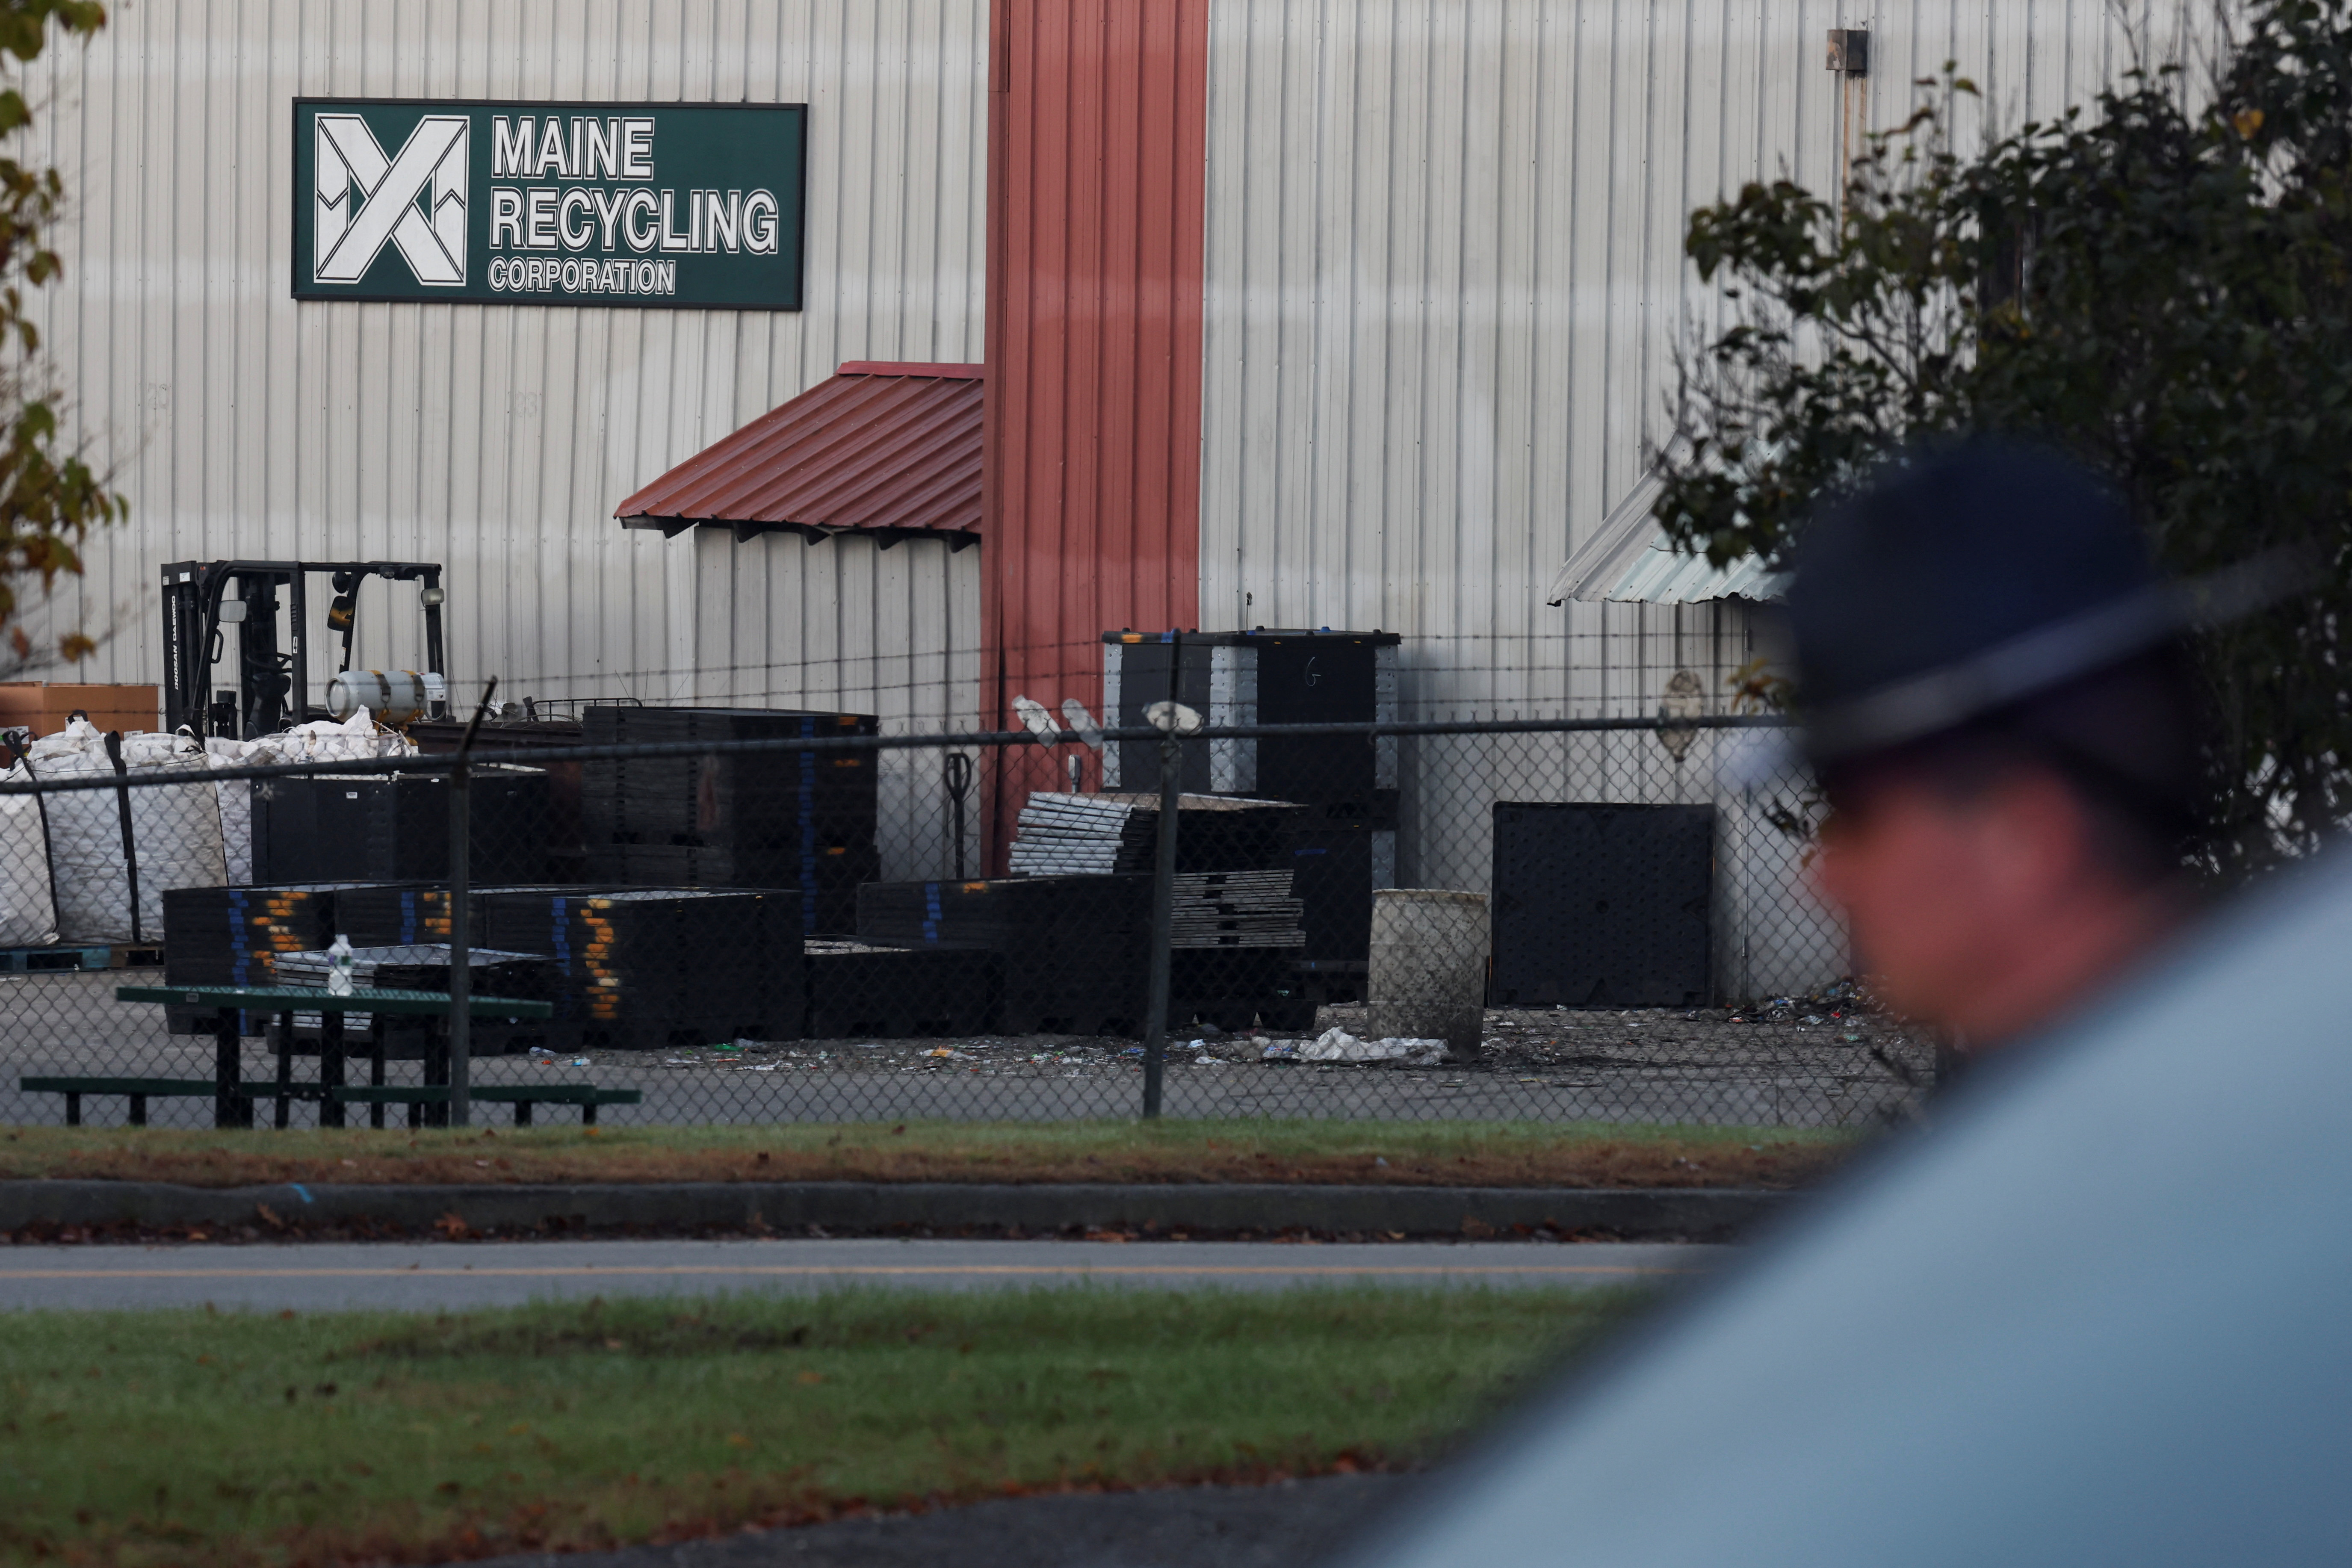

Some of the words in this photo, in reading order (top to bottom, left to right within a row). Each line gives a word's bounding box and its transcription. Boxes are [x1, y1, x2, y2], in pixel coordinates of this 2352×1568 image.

[491, 115, 655, 180] MAINE
[489, 186, 779, 255] RECYCLING
[488, 257, 676, 295] CORPORATION
